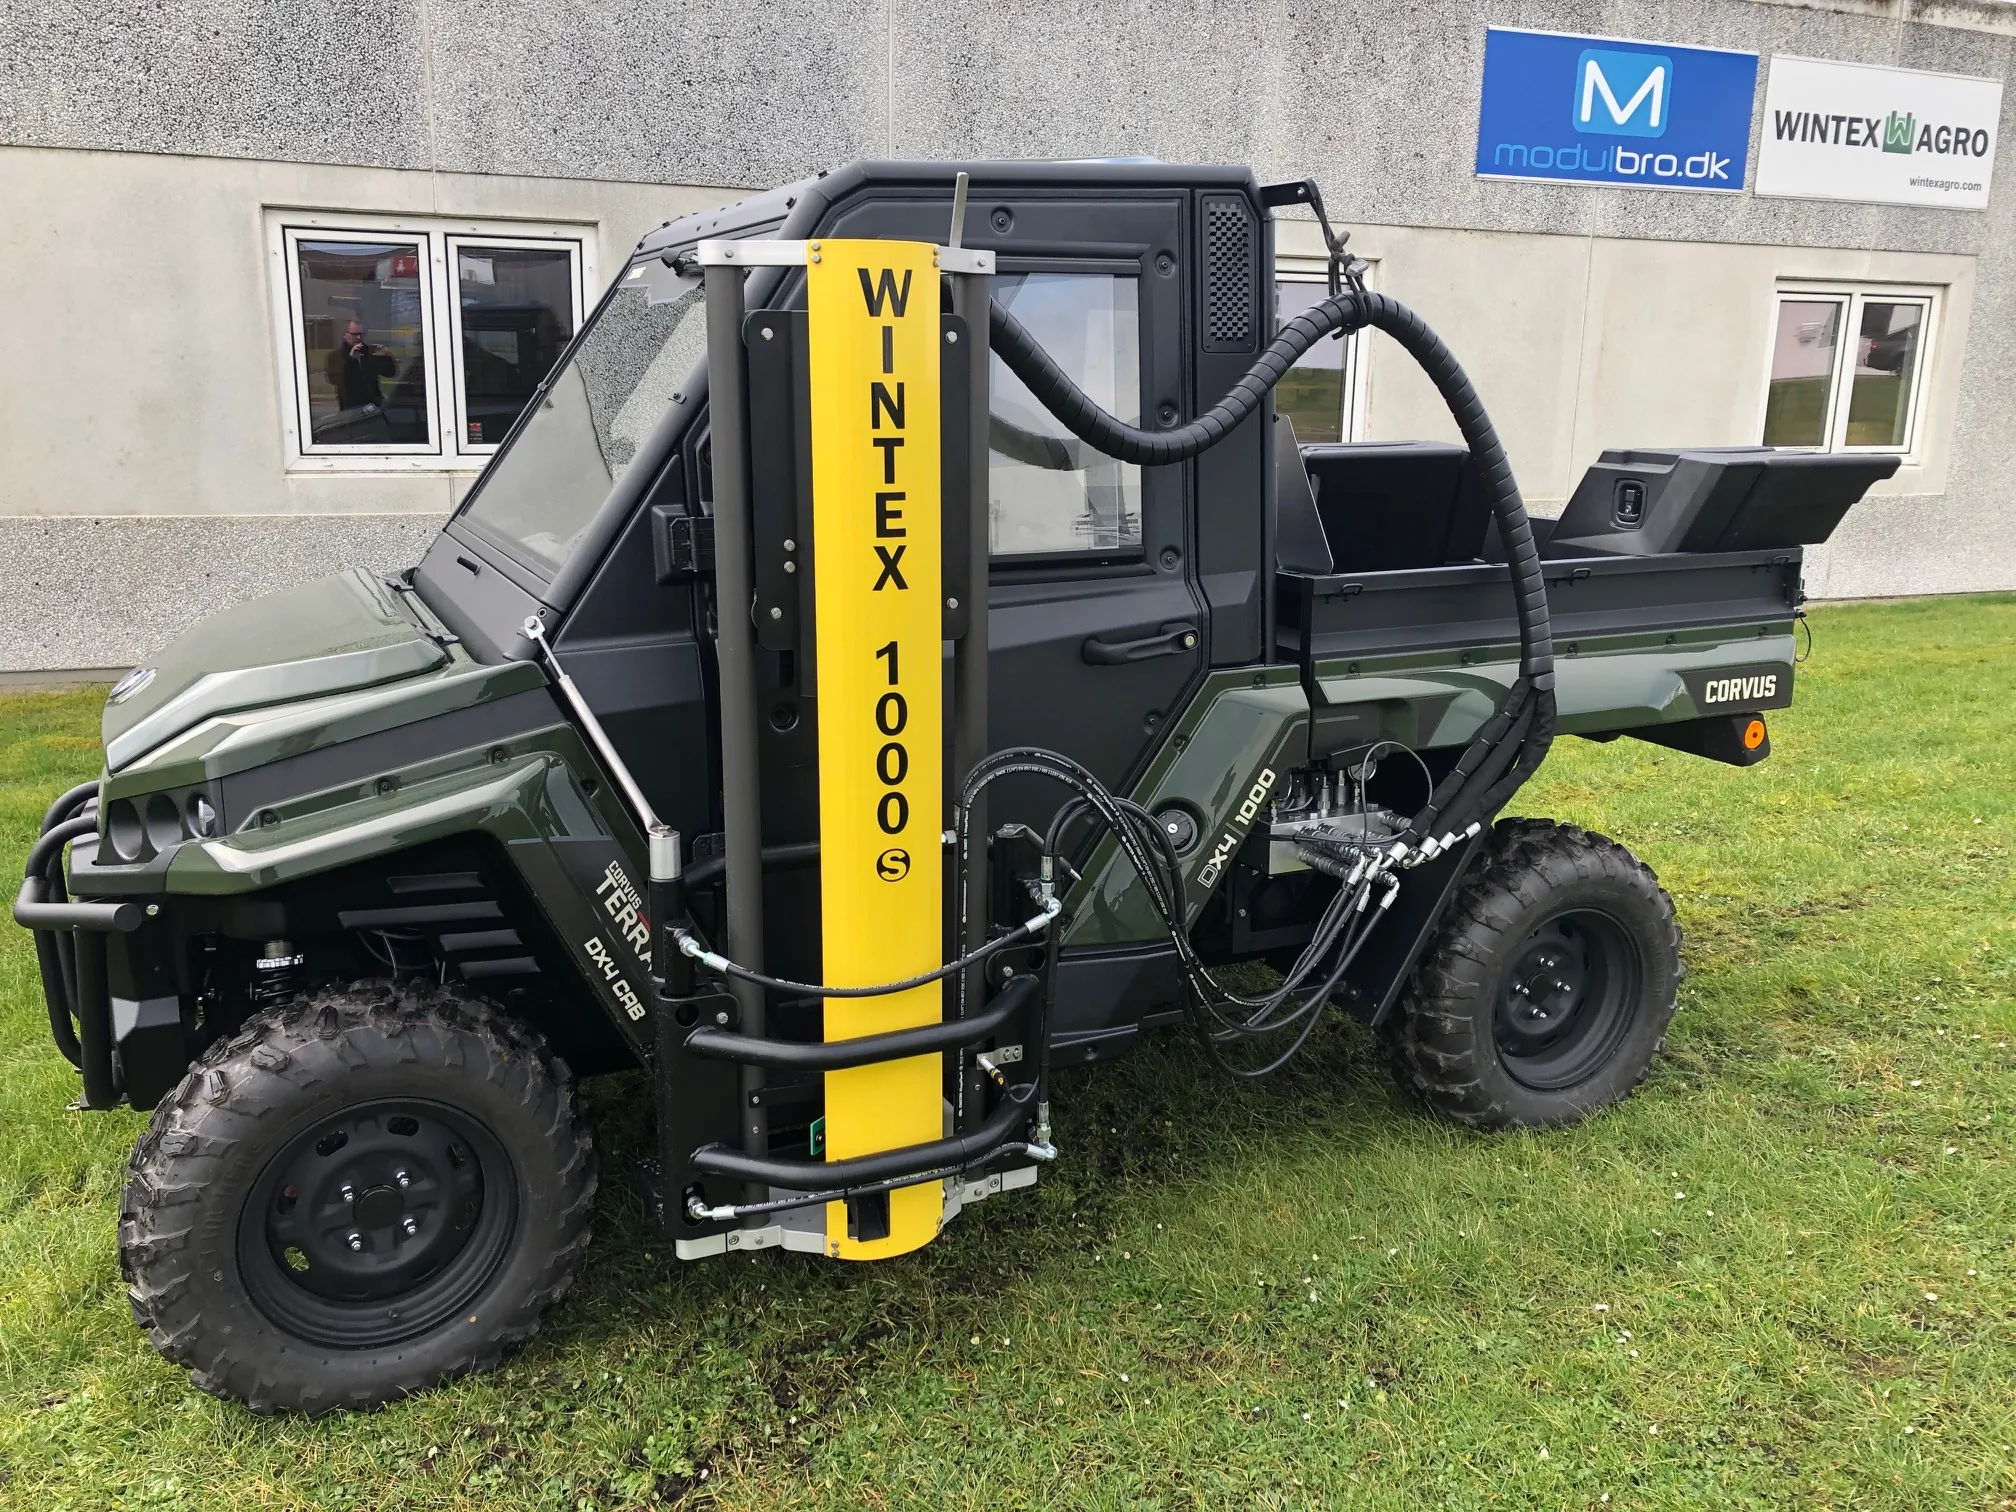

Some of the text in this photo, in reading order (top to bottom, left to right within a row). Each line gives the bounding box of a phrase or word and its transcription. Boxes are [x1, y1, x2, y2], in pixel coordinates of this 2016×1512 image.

[1580, 58, 1666, 128] M
[1494, 142, 1731, 181] modulbro.dk
[1774, 109, 1880, 149] WINTEX
[1916, 127, 1989, 159] AGRO
[1908, 175, 1982, 192] wintexagro.com
[857, 267, 913, 591] WINTEX
[1705, 674, 1777, 704] CORVUS
[875, 640, 910, 835] 1000
[1197, 768, 1276, 888] DX4 1000
[608, 860, 642, 910] CORVUS
[584, 936, 646, 1021] DX4 CAB
